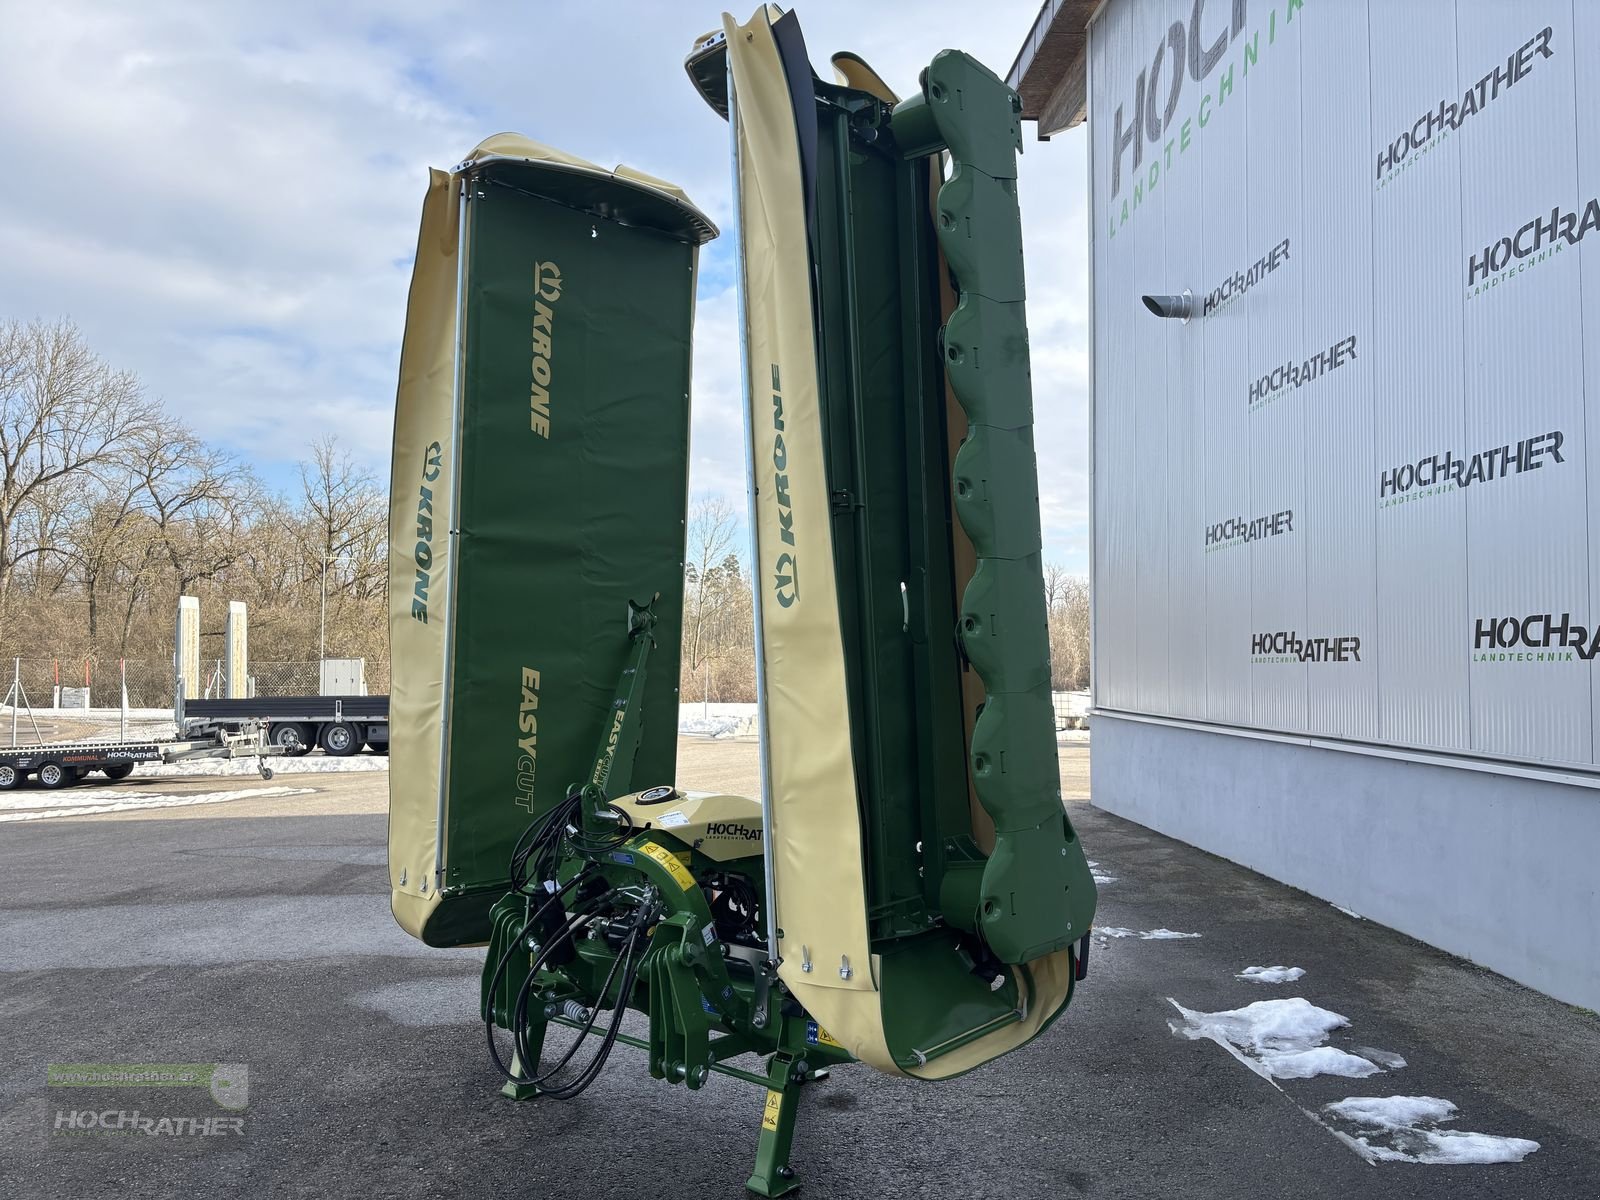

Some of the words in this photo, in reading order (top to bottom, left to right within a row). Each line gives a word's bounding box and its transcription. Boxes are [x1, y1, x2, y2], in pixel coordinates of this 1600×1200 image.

[1376, 26, 1554, 181] HOCHRATHER
[1375, 130, 1449, 192] LANDTECHNIK
[1203, 238, 1291, 317] HOCHRATHER
[1466, 241, 1563, 301] LANDTECHNIK
[530, 301, 553, 439] KRONE
[1249, 335, 1358, 405] HOCHRATHER
[771, 363, 795, 547] KRONE
[1380, 430, 1565, 498] HOCHRATHER
[1205, 509, 1294, 546] HOCHRATHER
[1379, 482, 1455, 509] LANDTECHNIK
[412, 485, 433, 625] KRONE
[1252, 631, 1361, 663] HOCHRATHER
[1473, 652, 1573, 662] LANDTECHNIK
[107, 751, 158, 759] HOCHRATHER
[513, 666, 540, 814] EASYCUT
